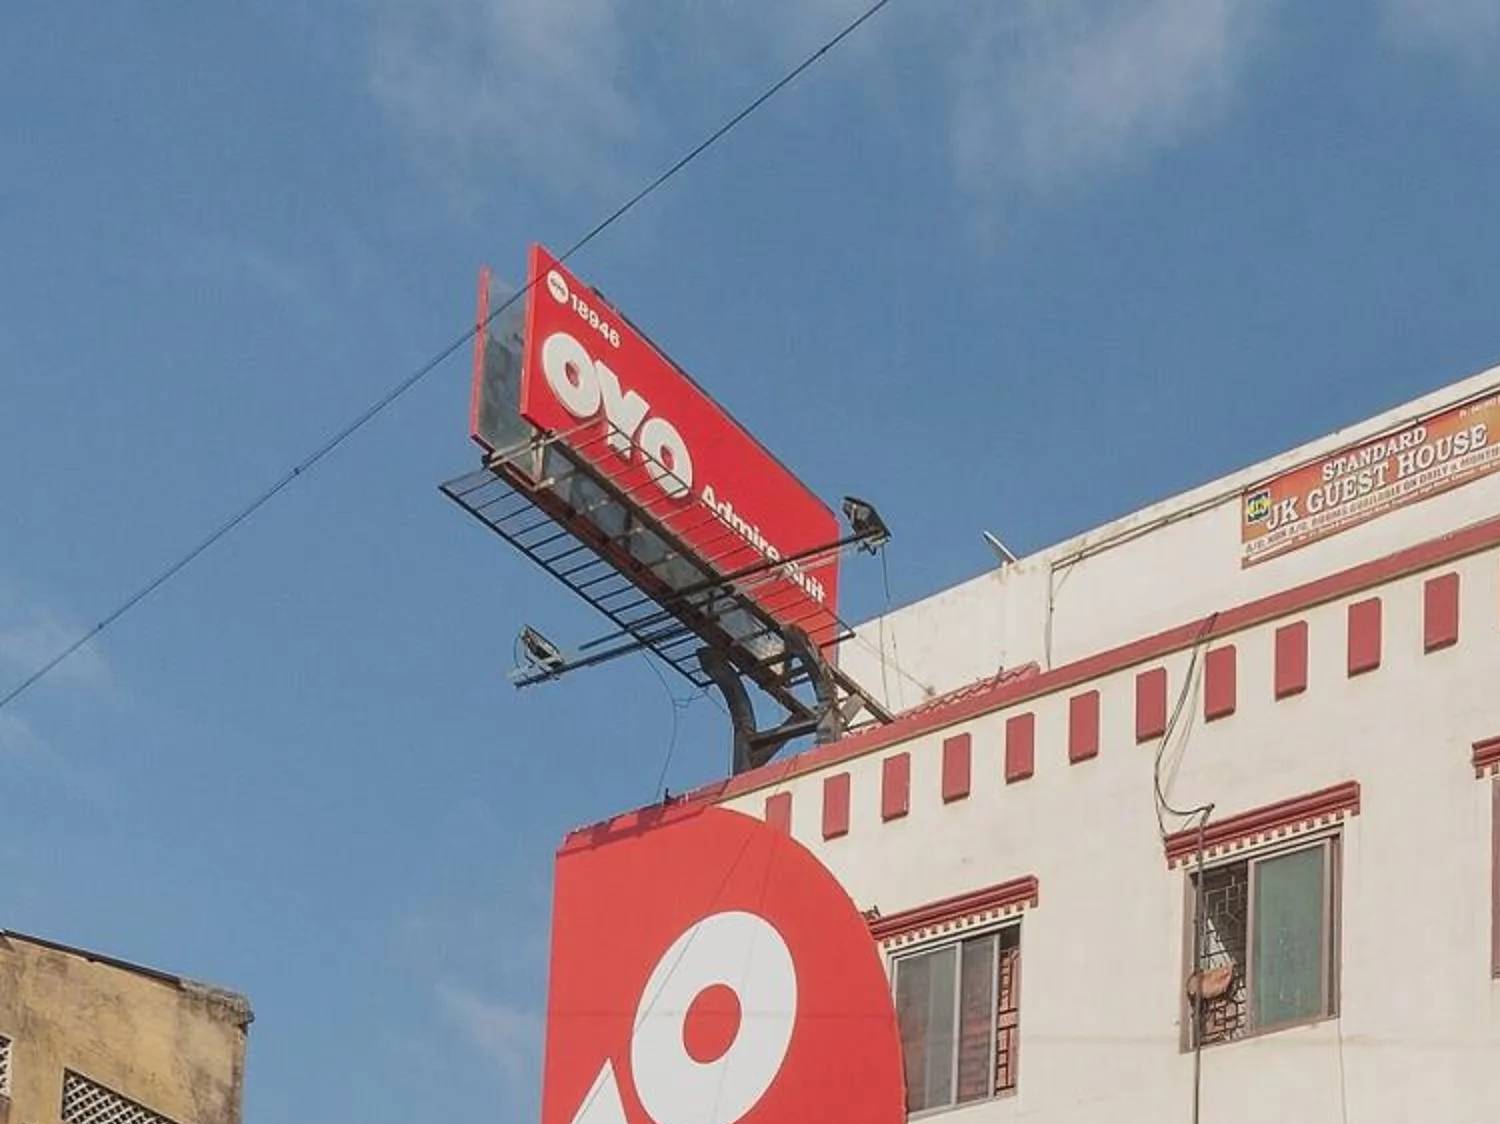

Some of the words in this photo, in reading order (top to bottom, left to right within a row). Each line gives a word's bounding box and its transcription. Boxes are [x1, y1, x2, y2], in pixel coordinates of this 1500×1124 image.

[571, 294, 621, 349] 18946
[541, 331, 694, 499] OYO
[1322, 426, 1428, 481] STANDARD
[1267, 495, 1299, 531] JK
[1306, 460, 1390, 514] GUEST
[1397, 423, 1488, 479] HOUSE
